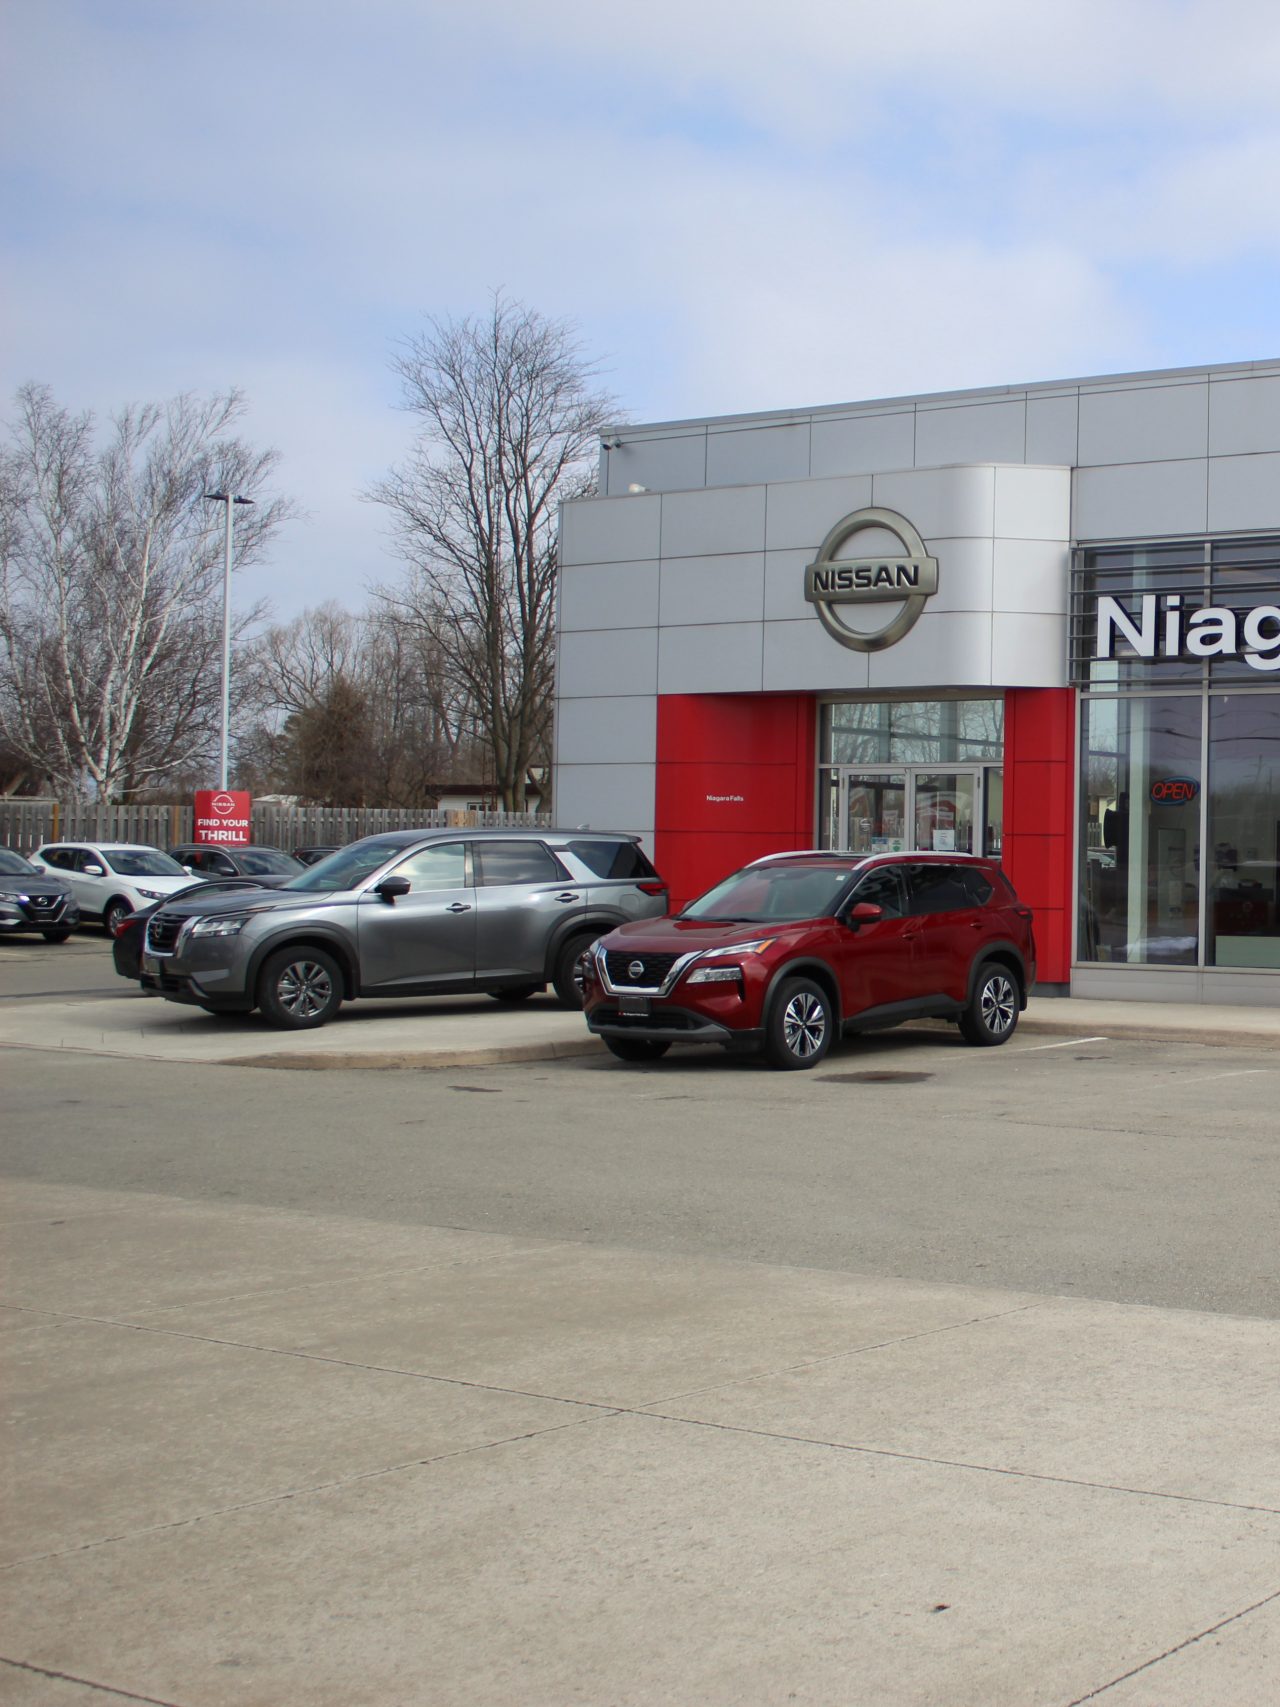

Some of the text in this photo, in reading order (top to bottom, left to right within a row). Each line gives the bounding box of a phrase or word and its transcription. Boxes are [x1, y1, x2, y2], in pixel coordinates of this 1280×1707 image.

[813, 564, 919, 592] NISSAN
[1151, 783, 1194, 800] OPEN
[199, 830, 247, 841] THRILL
